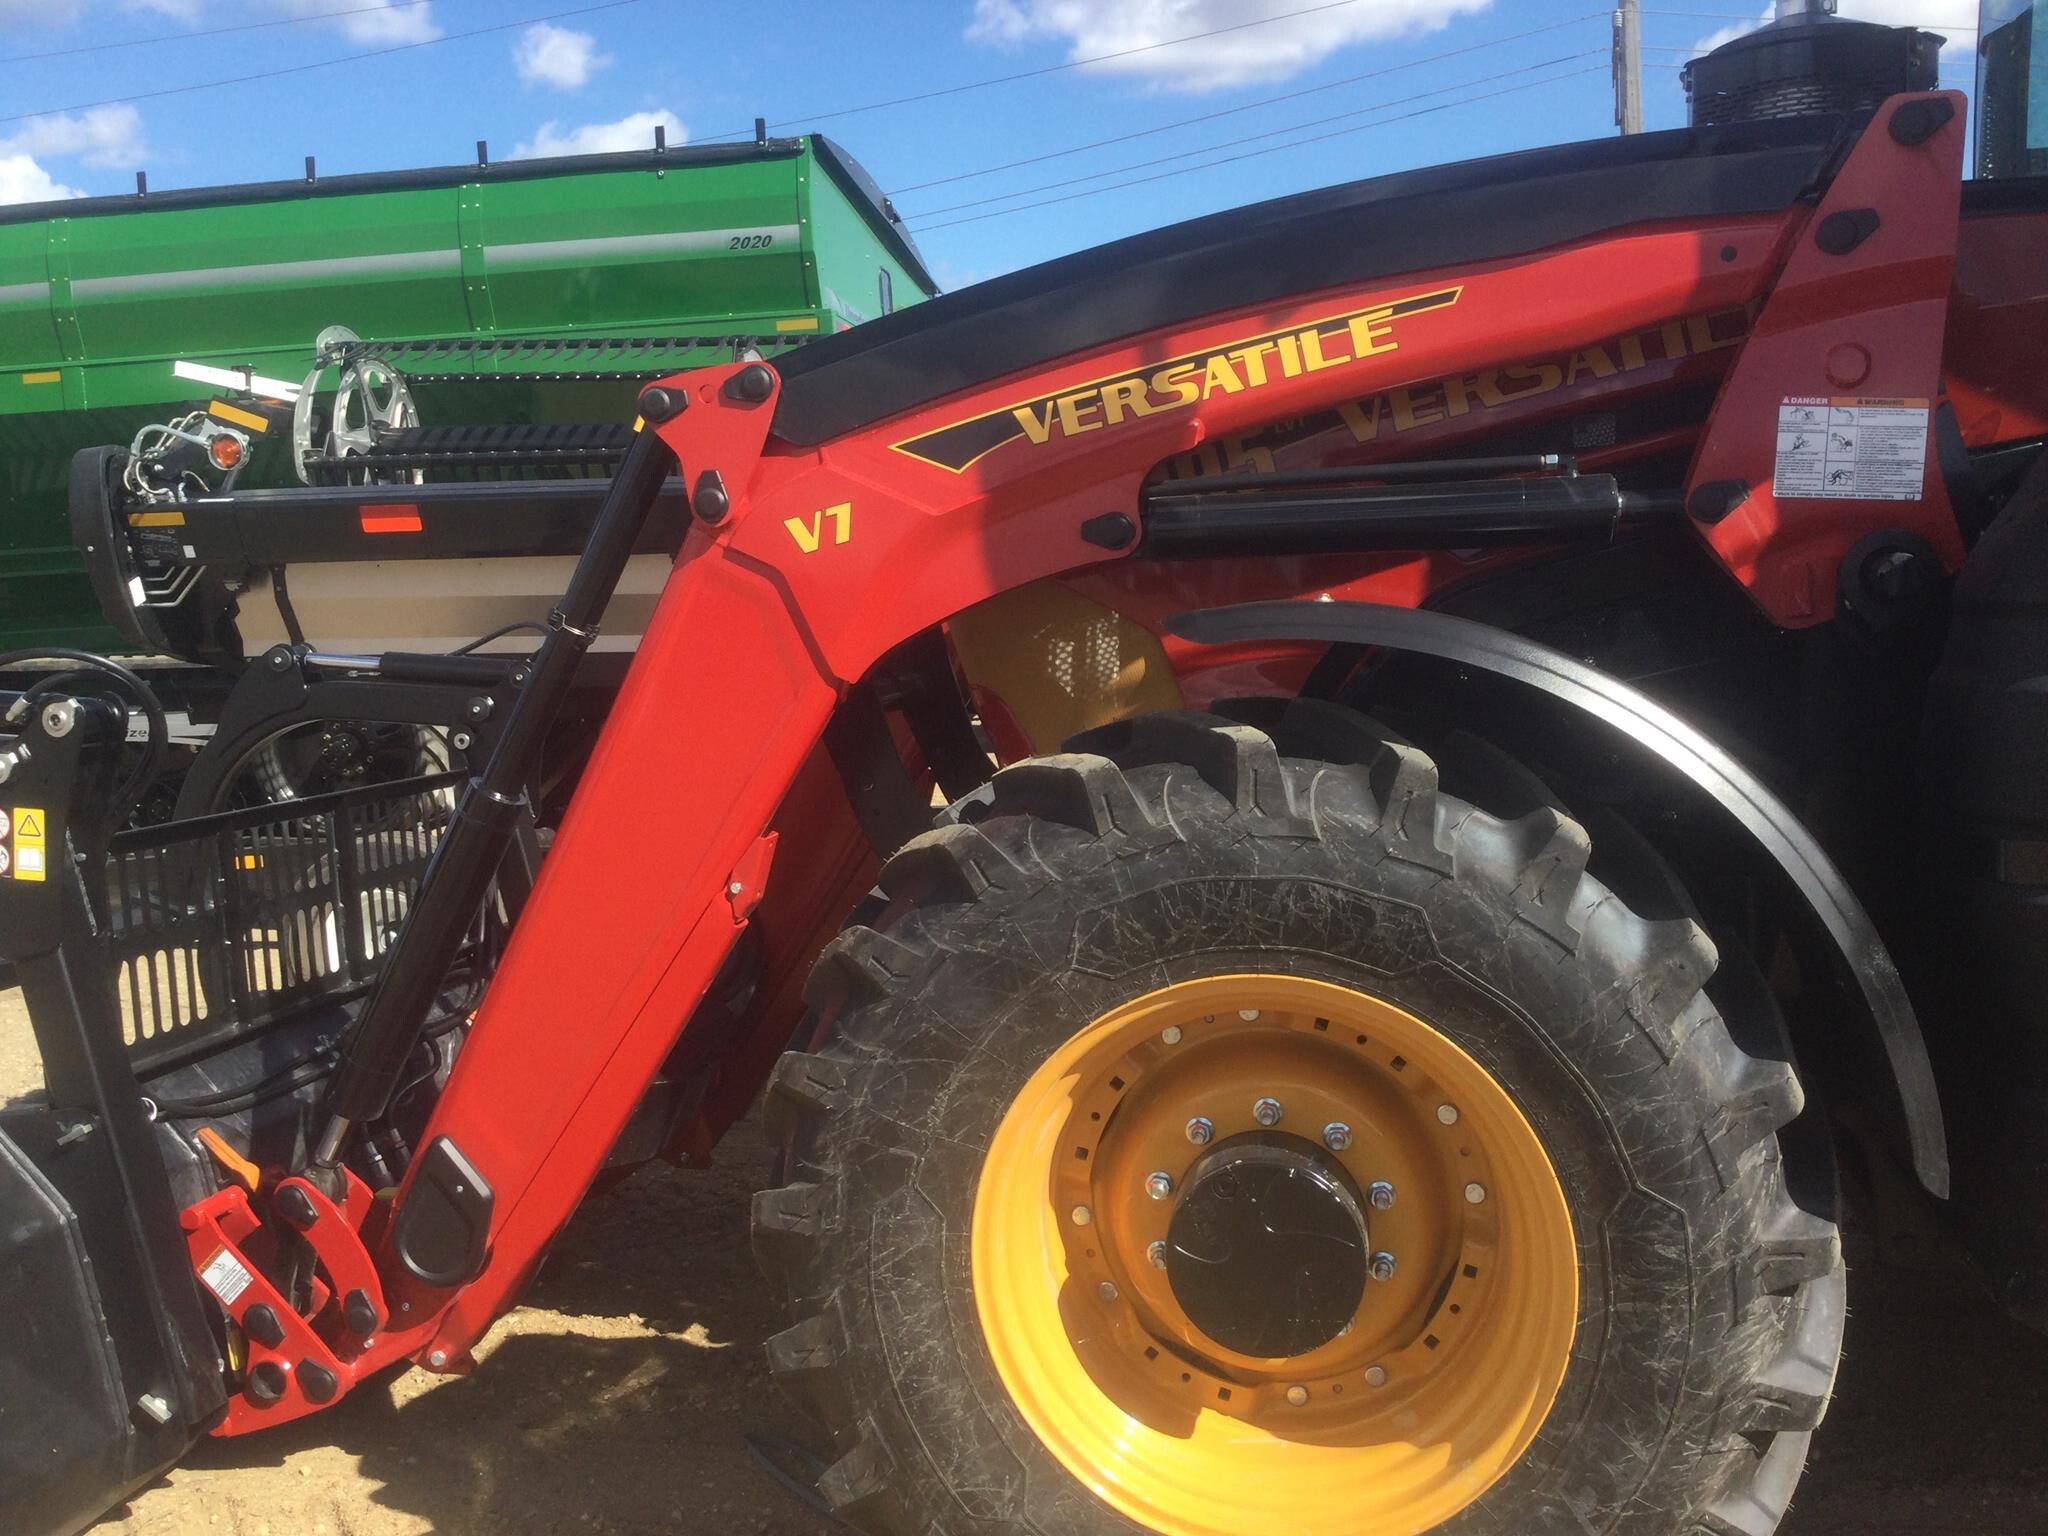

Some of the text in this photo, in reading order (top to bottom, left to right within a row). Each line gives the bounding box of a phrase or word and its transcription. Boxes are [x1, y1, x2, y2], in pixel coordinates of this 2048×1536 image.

[729, 234, 773, 250] 2020
[1012, 307, 1400, 445] VERSATILE
[1333, 303, 1755, 443] VERSATIL
[1791, 397, 1828, 405] DANGER
